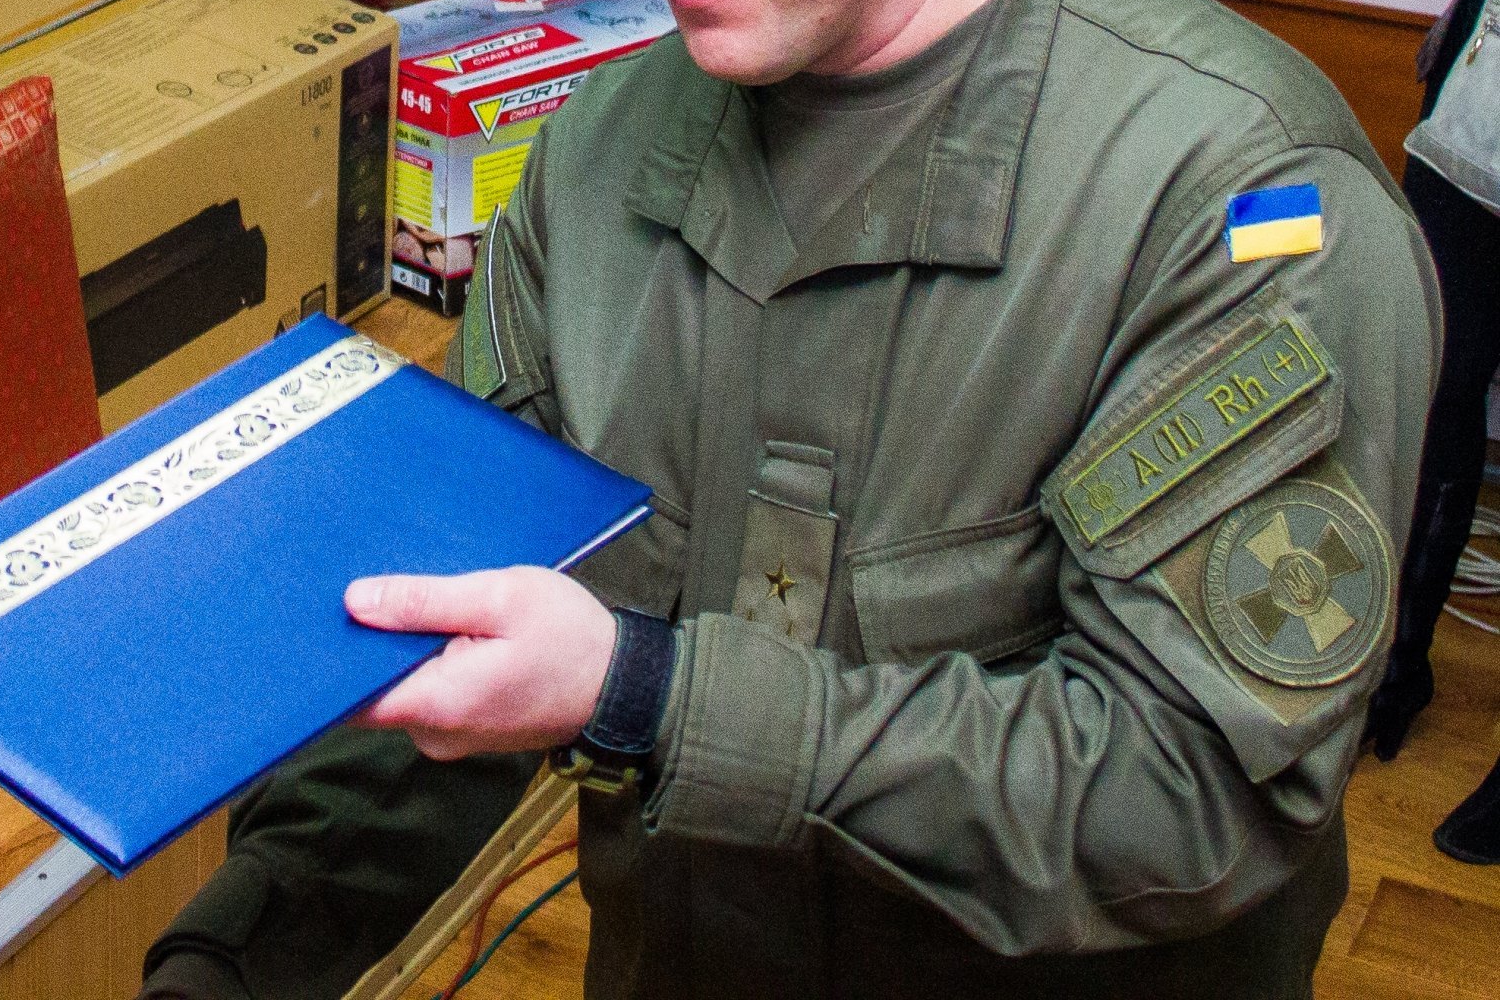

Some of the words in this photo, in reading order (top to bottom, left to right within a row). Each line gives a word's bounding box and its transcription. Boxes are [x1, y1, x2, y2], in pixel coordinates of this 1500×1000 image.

[453, 28, 543, 61] FORTE
[472, 50, 510, 66] CHAIN
[512, 41, 539, 56] SAW
[501, 73, 586, 110] FORTE
[508, 103, 536, 123] CHAIN
